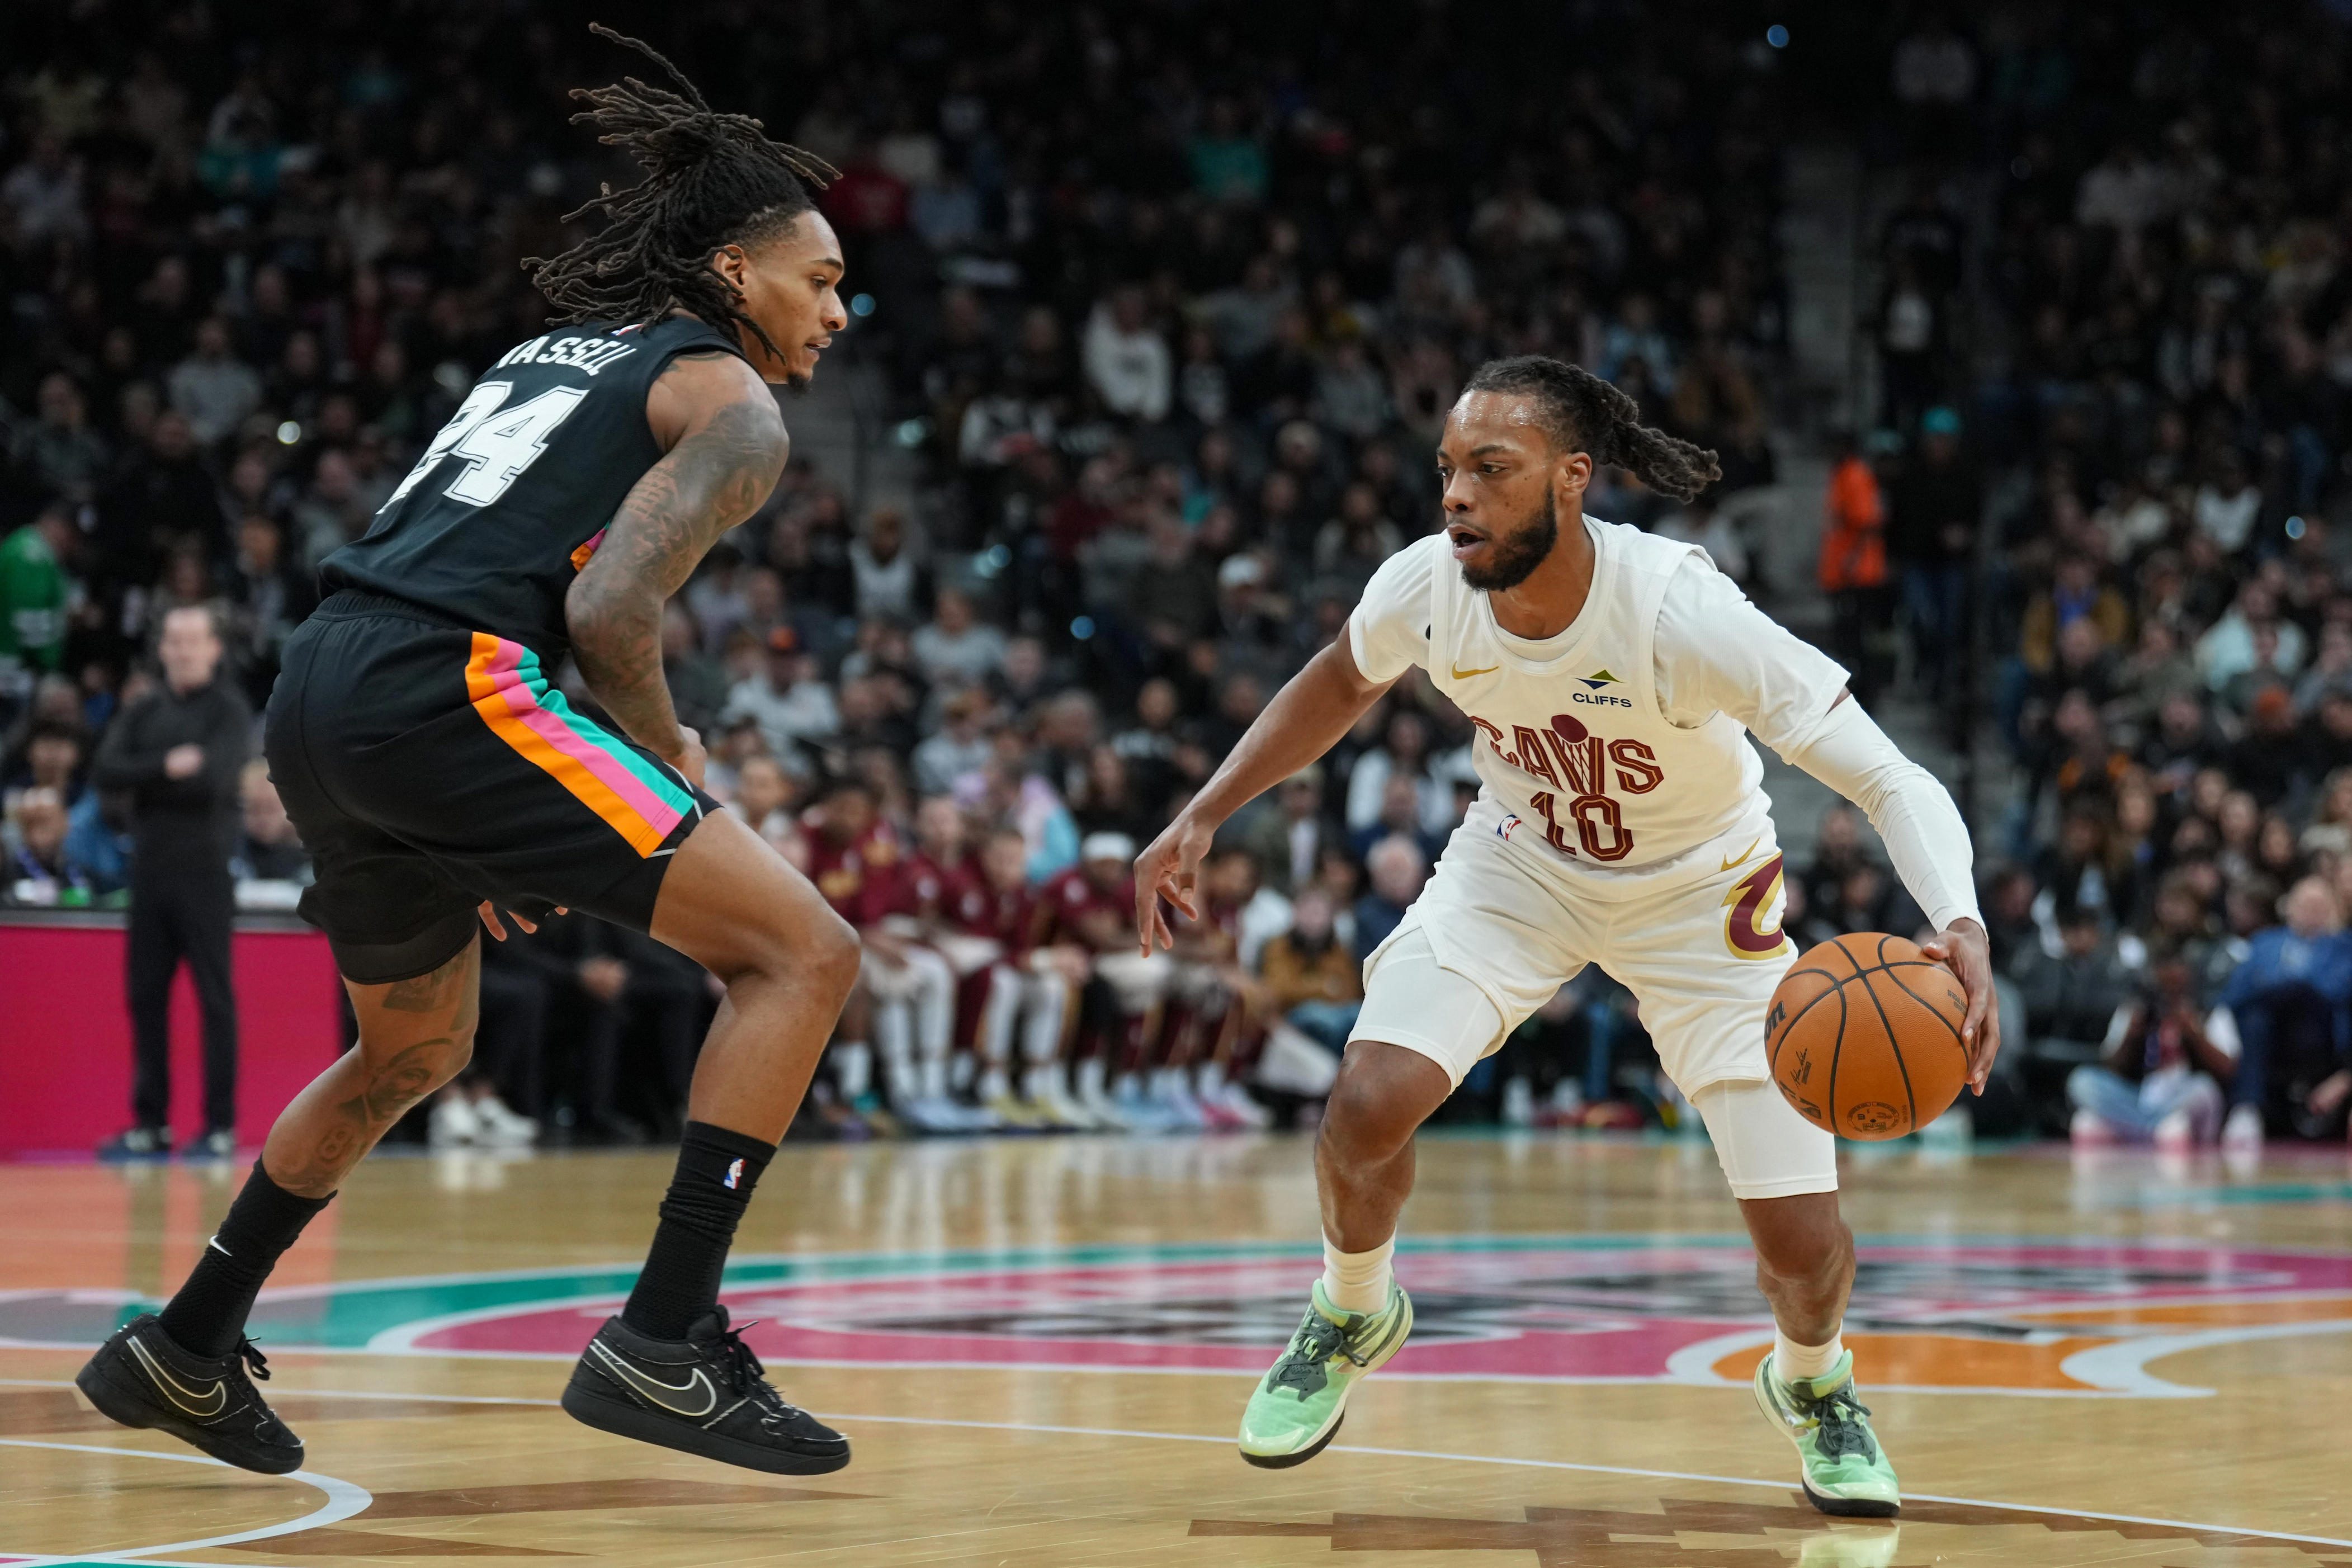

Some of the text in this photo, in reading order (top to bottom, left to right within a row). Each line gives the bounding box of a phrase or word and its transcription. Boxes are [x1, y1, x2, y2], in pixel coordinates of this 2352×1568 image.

[1572, 693, 1632, 707] CLIFFS
[1468, 715, 1664, 795] CAVS
[1530, 791, 1635, 862] 10
